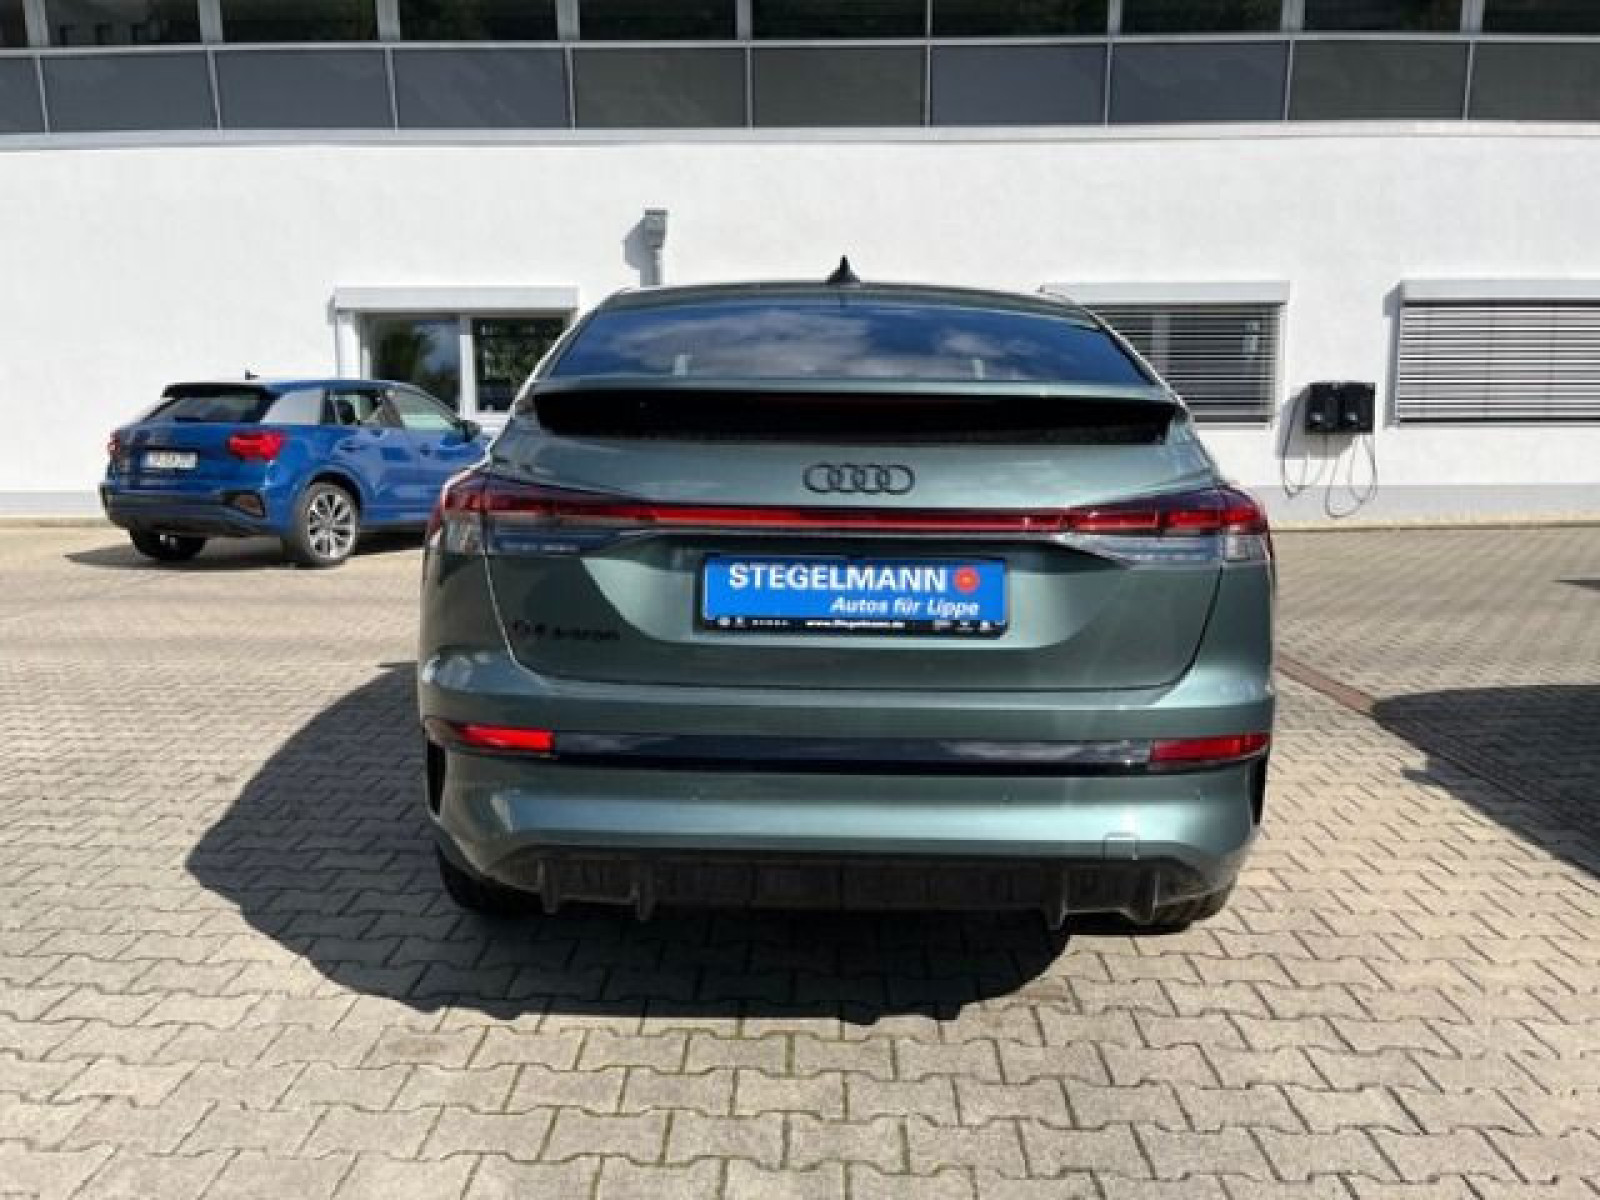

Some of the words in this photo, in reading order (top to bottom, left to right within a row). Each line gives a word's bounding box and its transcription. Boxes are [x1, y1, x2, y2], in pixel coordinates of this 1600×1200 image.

[728, 563, 948, 592] STEGELMANN
[830, 596, 887, 615] Autos
[893, 597, 922, 616] für
[926, 598, 980, 620] Lippe
